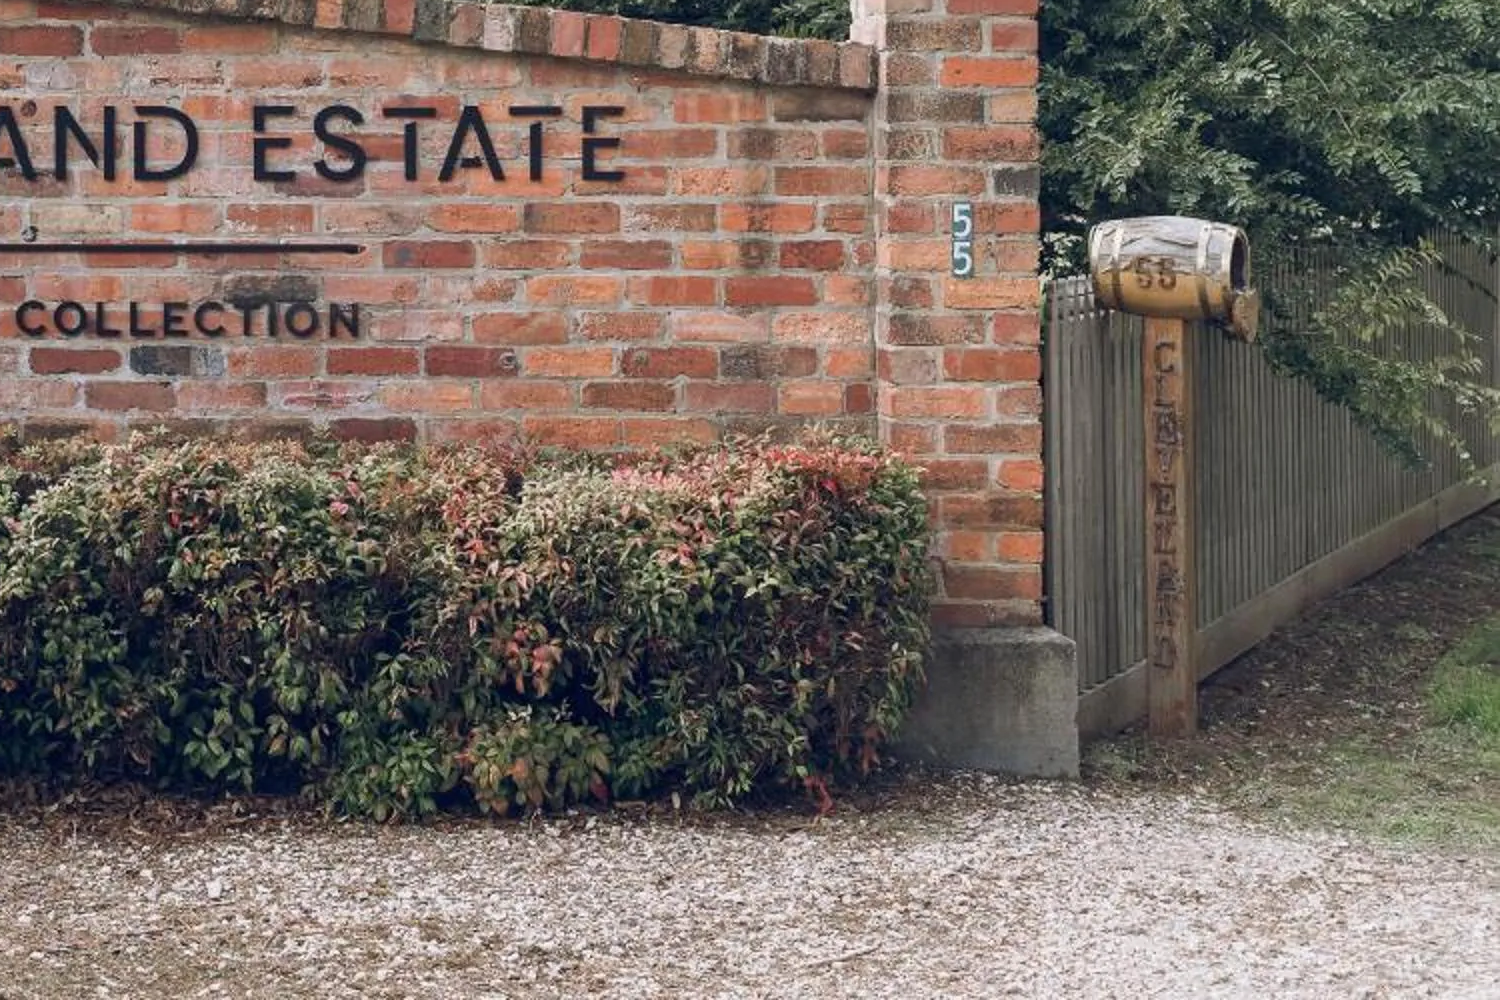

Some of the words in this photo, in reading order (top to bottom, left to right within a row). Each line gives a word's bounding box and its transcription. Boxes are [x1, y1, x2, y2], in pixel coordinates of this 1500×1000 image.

[252, 104, 628, 182] ESTATE
[953, 203, 973, 275] 55
[15, 299, 361, 338] COLLECTION
